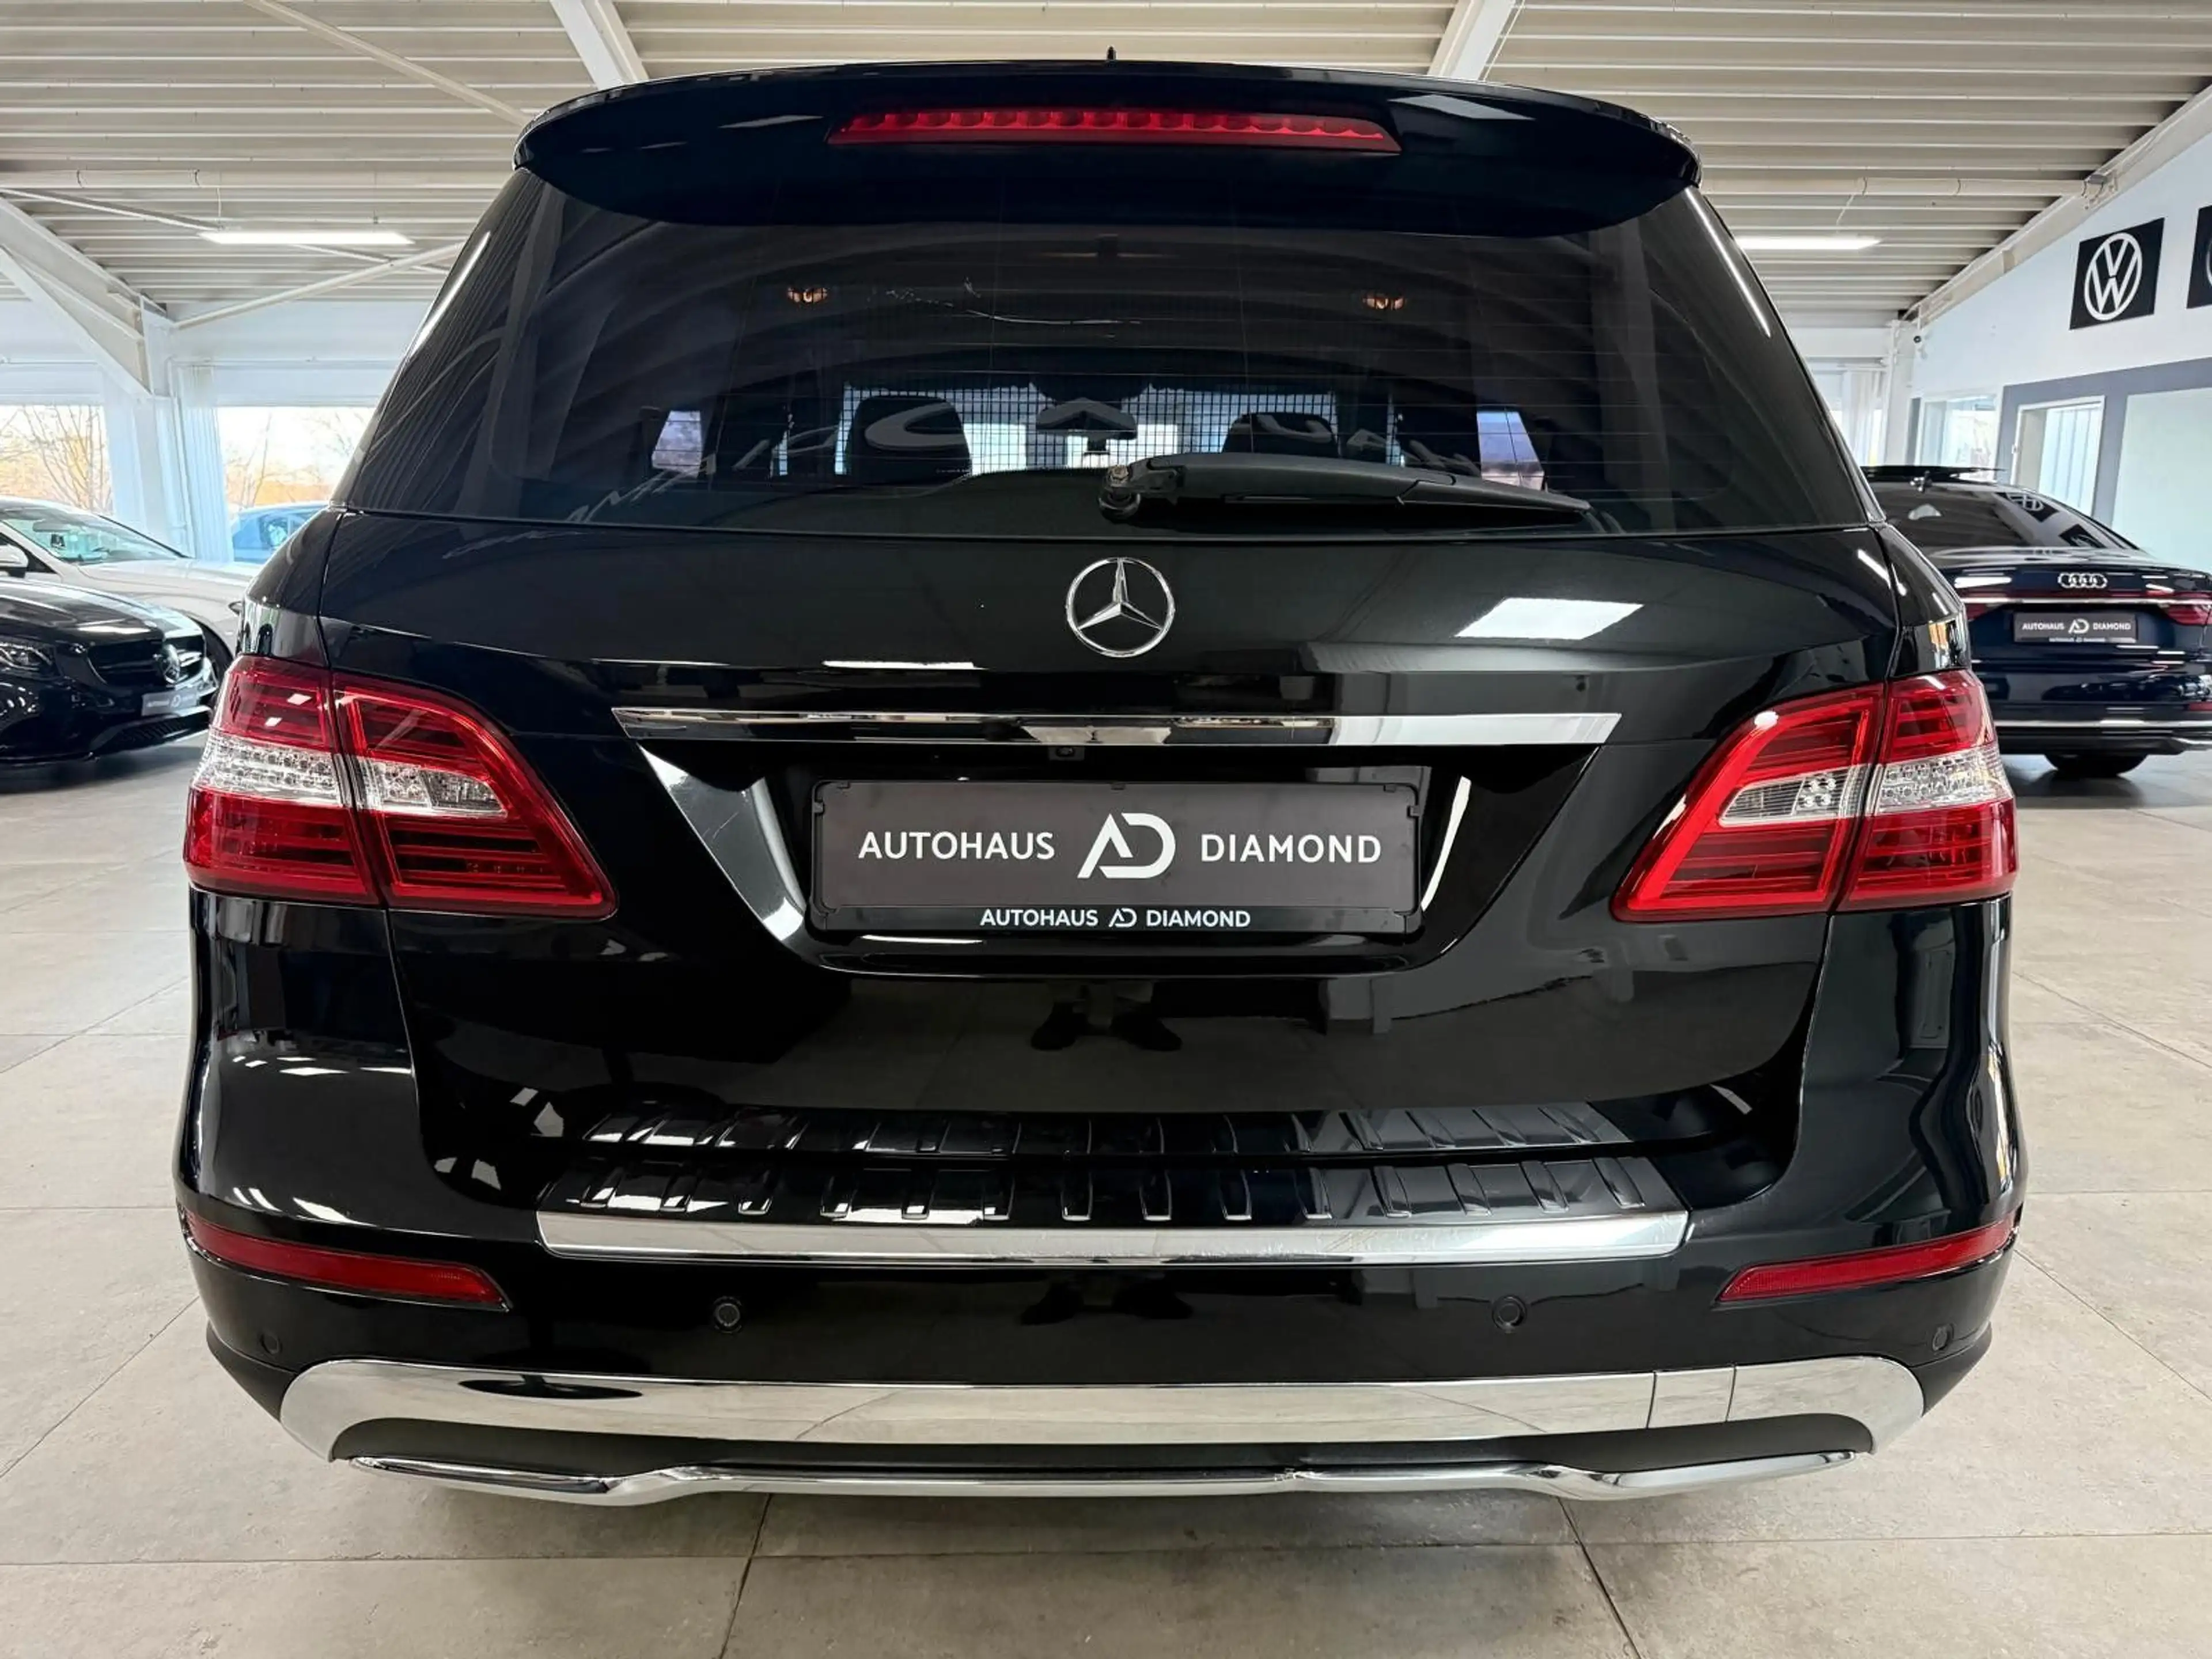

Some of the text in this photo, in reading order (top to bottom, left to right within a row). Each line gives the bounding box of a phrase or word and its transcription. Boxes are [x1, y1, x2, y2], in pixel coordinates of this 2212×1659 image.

[2022, 622, 2065, 630] AUTOHAUS
[2092, 622, 2132, 630] DIAMOND
[858, 831, 1055, 861] AUTOHAUS
[1200, 834, 1382, 863] DIAMOND
[979, 908, 1099, 927] AUTOHAUS
[1146, 910, 1252, 927] DIAMOND
